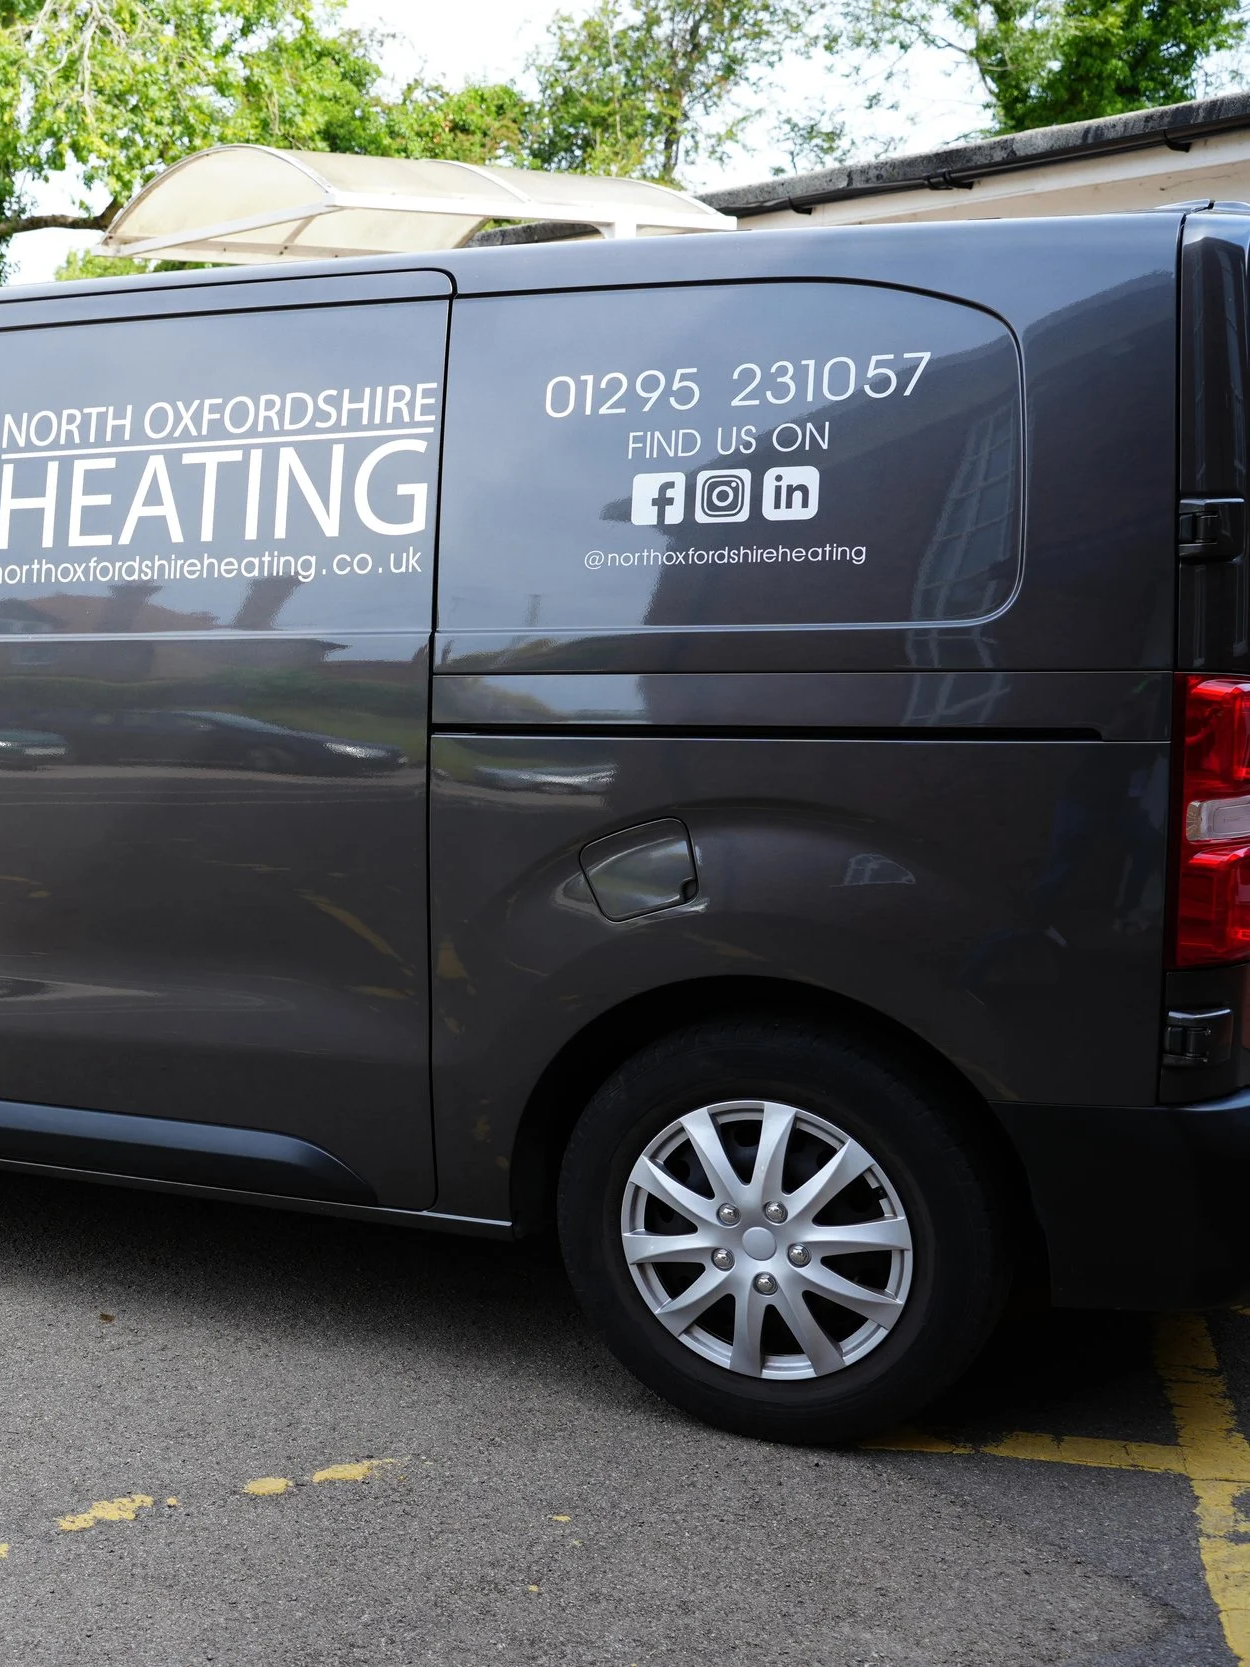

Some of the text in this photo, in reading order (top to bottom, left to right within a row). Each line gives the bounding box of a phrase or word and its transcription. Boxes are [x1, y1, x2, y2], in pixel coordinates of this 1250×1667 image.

[545, 352, 932, 418] 01295 231057
[2, 383, 438, 449] NORTH OXFORDSHIRE
[628, 421, 830, 460] FIND US ON
[584, 543, 867, 570] @northoxfordshireheating
